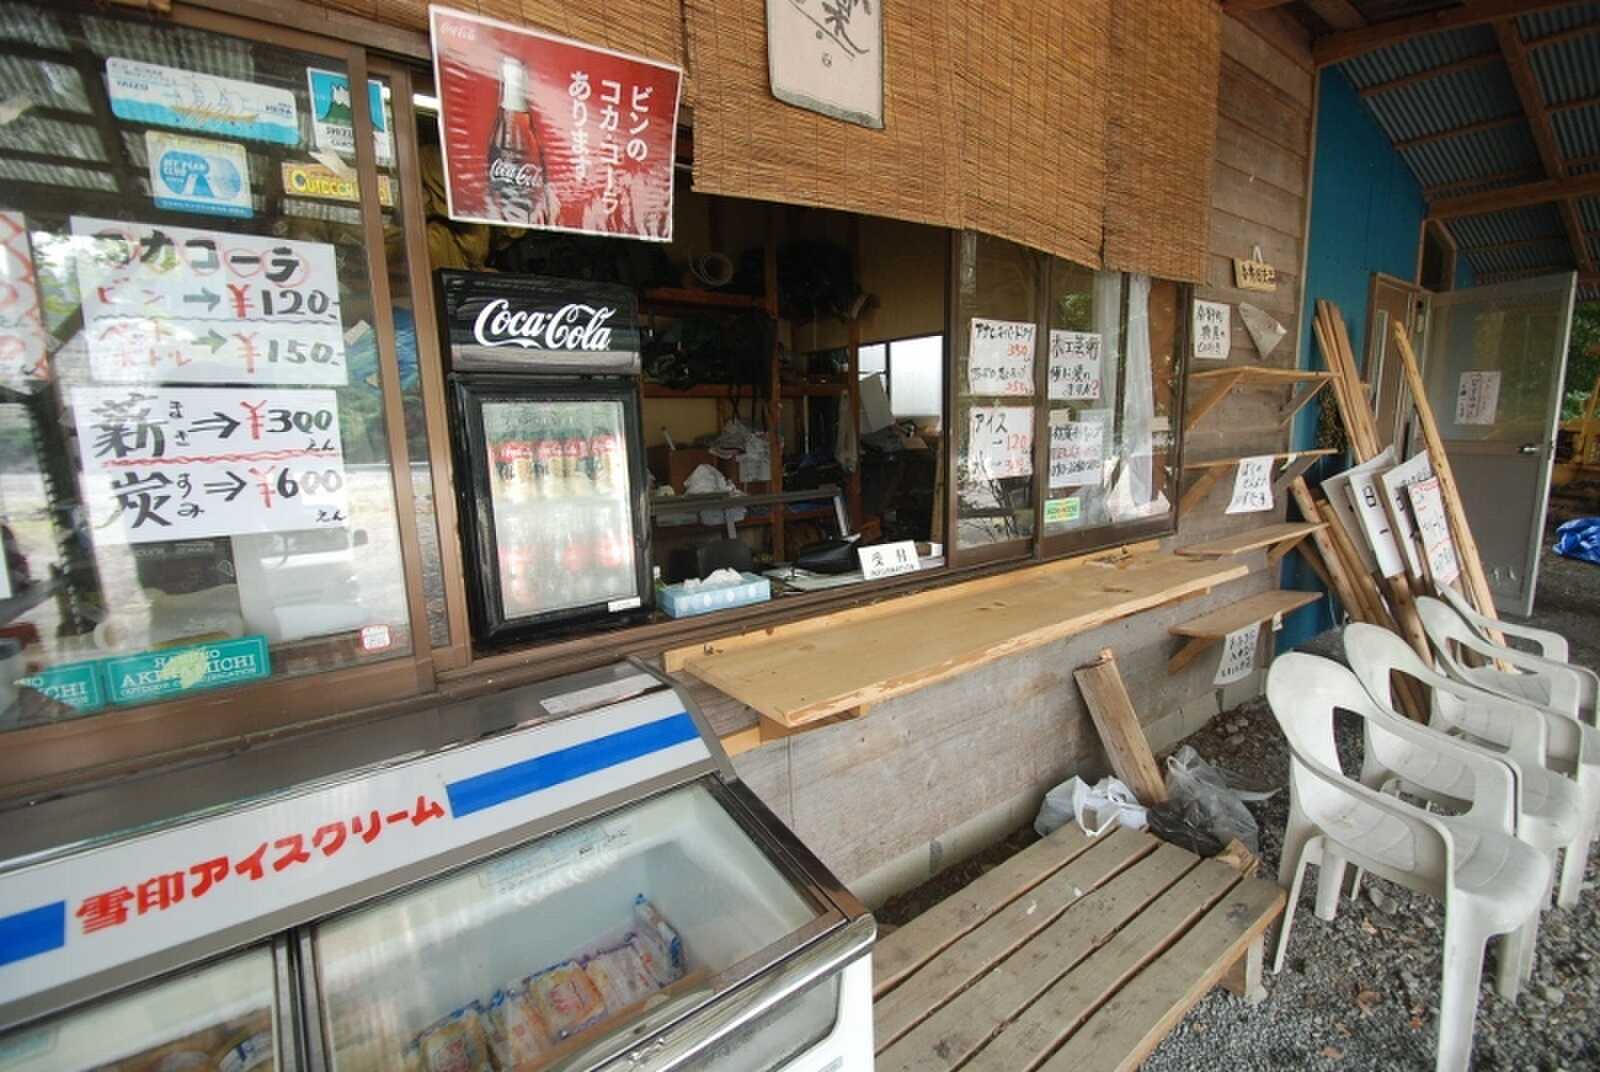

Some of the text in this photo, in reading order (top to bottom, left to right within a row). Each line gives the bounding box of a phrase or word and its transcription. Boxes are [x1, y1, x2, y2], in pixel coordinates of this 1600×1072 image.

[567, 70, 593, 184] あります
[600, 78, 622, 216] コカ・コーラ
[625, 85, 653, 162] ビンの
[473, 298, 617, 351] Coca-Cola
[975, 413, 1008, 433] アイス
[75, 795, 446, 935] 雪印アイスクリーム
